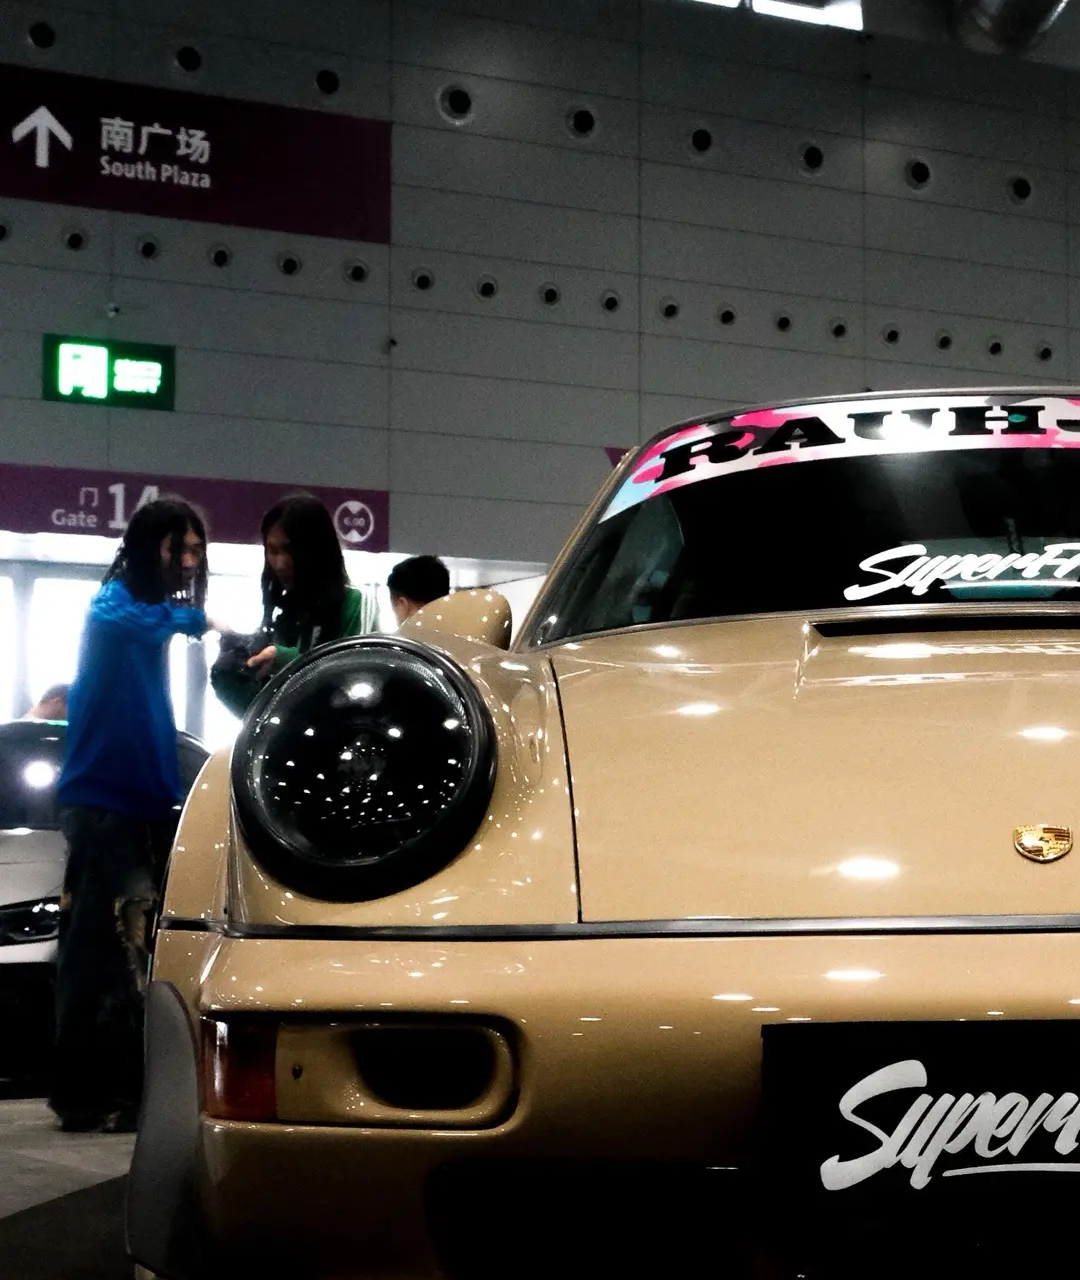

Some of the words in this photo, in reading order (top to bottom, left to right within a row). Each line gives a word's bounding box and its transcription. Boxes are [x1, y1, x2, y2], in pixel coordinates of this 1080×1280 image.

[100, 117, 210, 164] 南广场
[100, 155, 157, 181] South
[161, 163, 211, 188] Plaza
[51, 508, 98, 528] Gate
